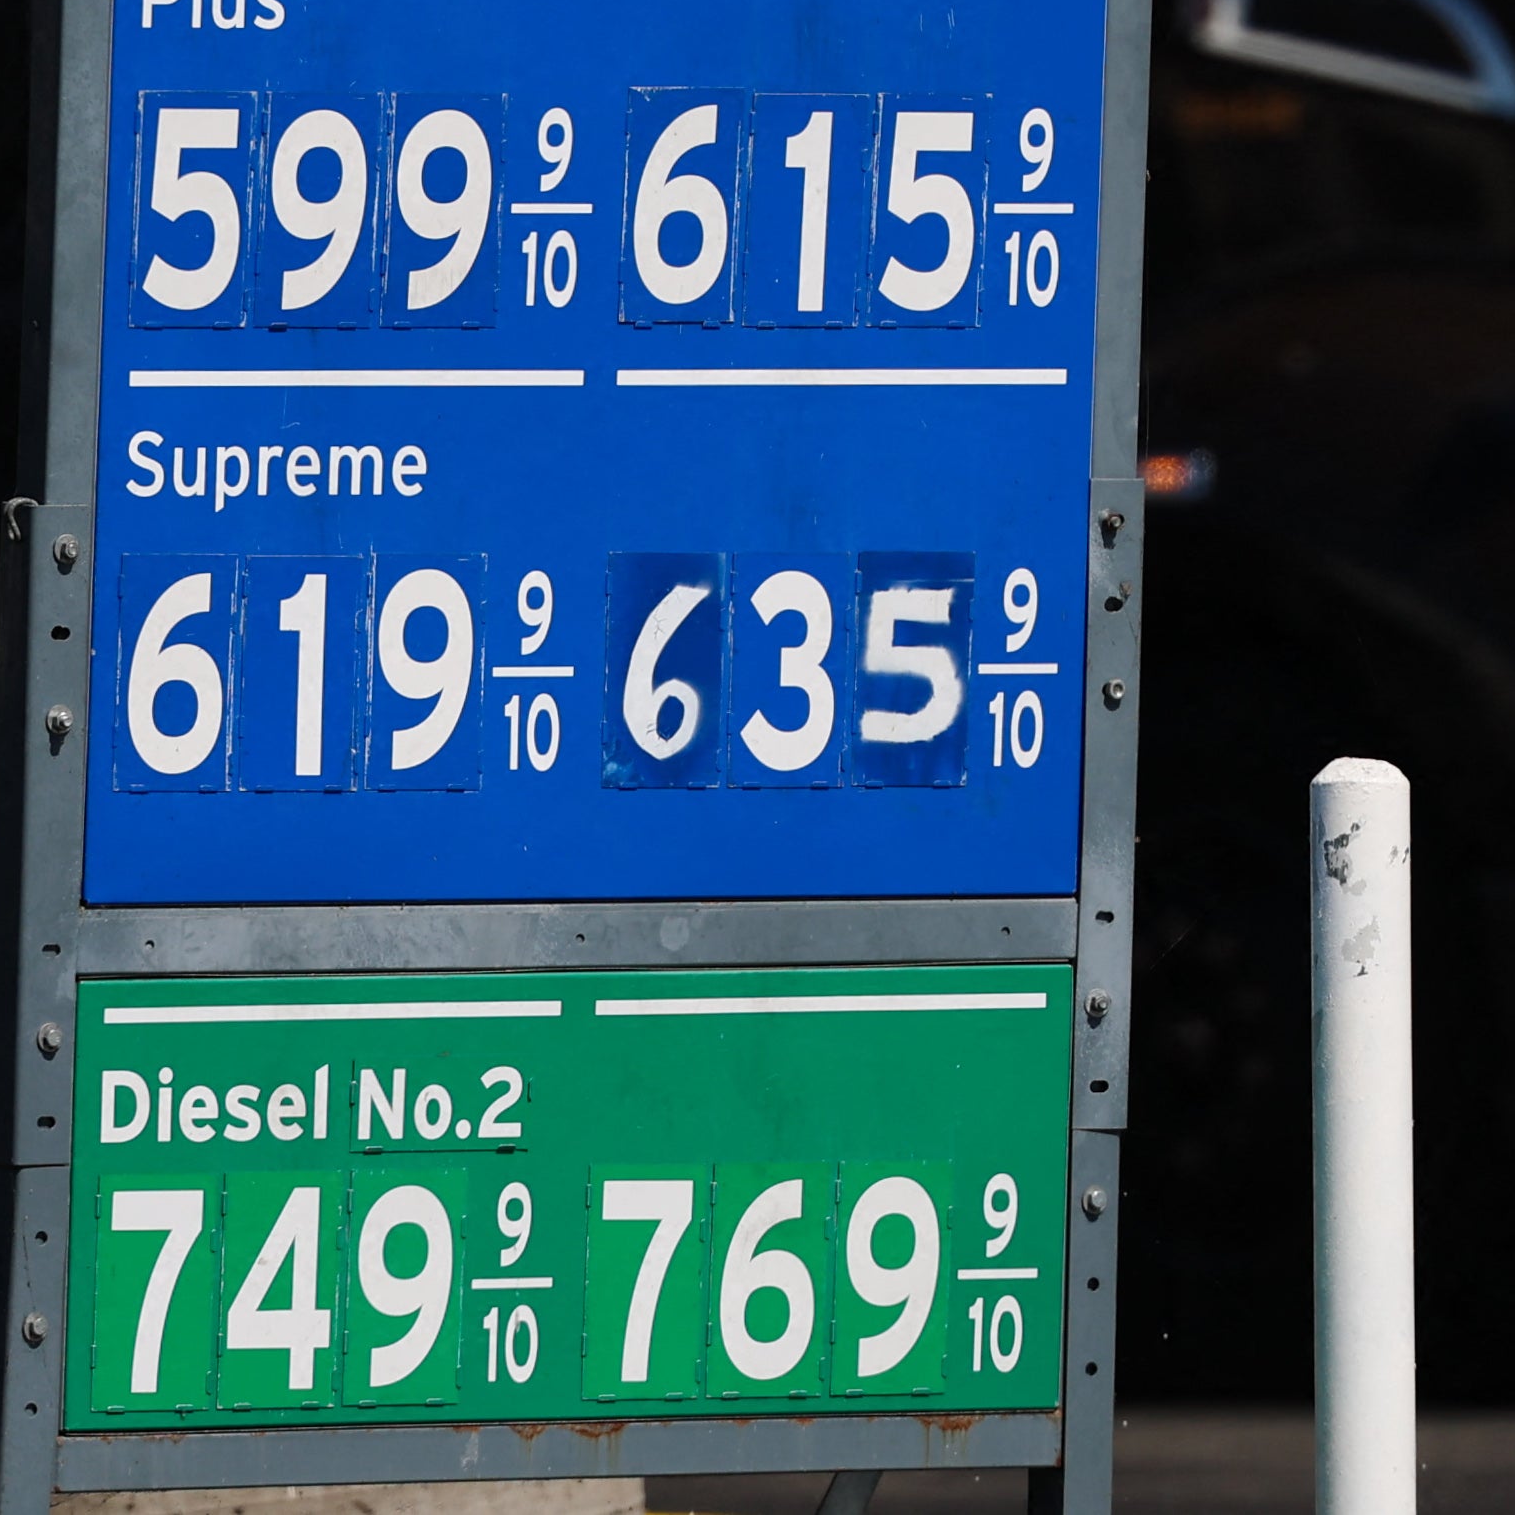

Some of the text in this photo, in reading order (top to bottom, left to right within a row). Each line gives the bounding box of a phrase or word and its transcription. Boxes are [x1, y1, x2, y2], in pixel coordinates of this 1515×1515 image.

[140, 107, 494, 312] 599
[631, 102, 977, 314] 615
[124, 428, 429, 514] Supreme
[125, 567, 476, 777] 619
[621, 569, 965, 773] 635
[98, 1062, 525, 1146] Diesel No.2
[109, 1184, 455, 1394] 749
[600, 1174, 942, 1383] 769
